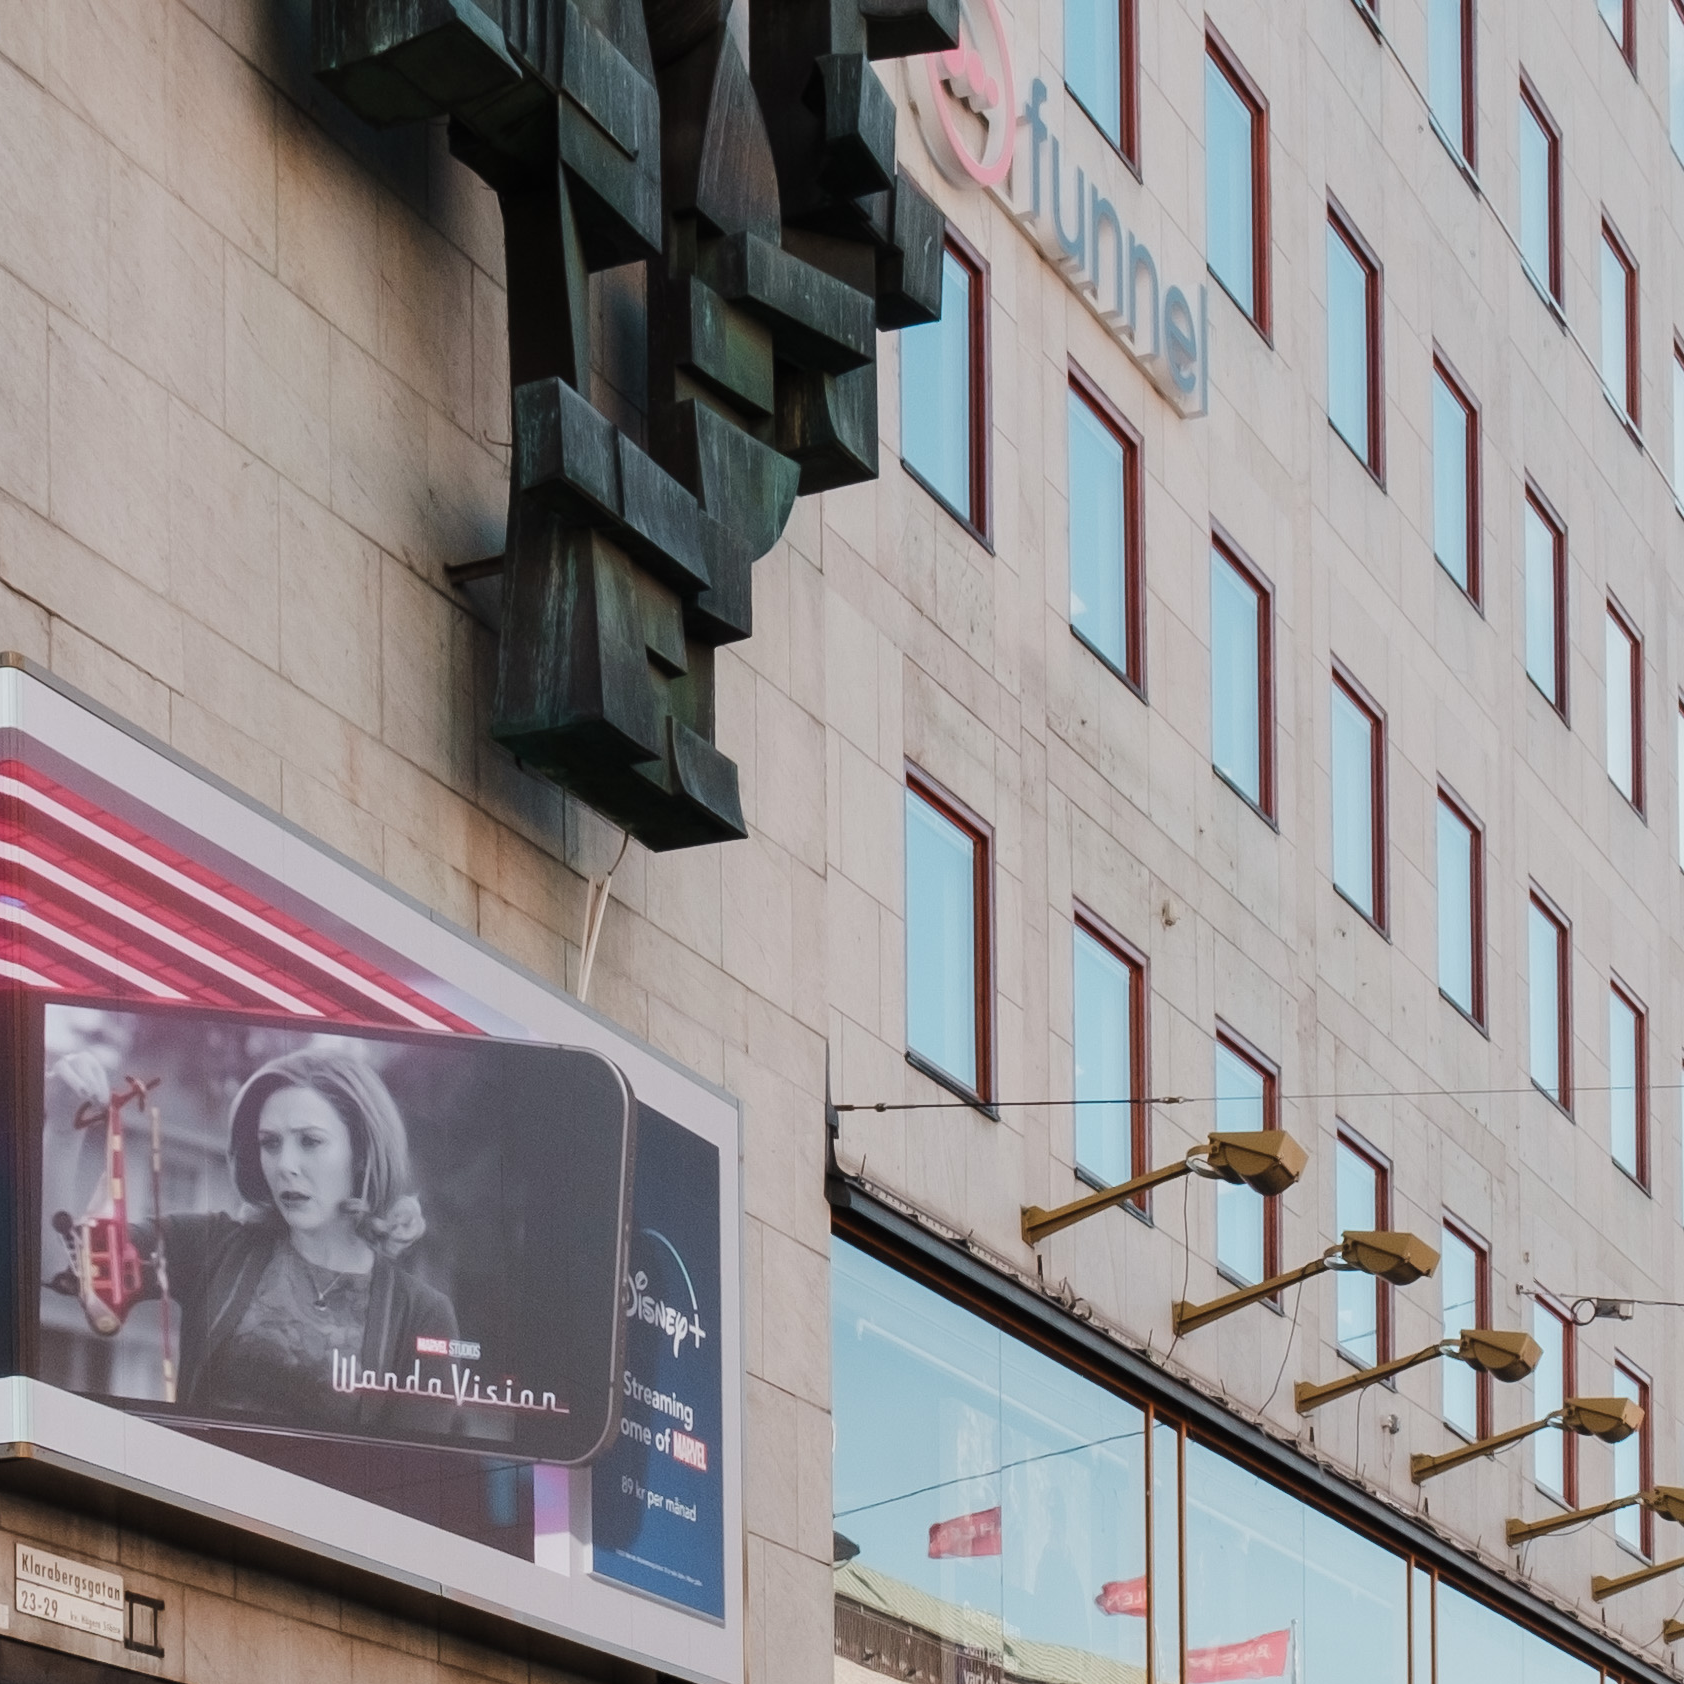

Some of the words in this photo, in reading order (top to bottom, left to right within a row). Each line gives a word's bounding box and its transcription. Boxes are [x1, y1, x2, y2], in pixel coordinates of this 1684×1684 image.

[1025, 77, 1209, 415] funnel
[623, 1370, 694, 1431] Streaming
[620, 1417, 652, 1446] ome
[655, 1428, 671, 1454] of
[672, 1430, 708, 1471] MARVEL
[621, 1475, 633, 1494] 89
[635, 1481, 646, 1500] kr
[647, 1490, 664, 1509] per
[665, 1496, 697, 1523] månad
[20, 1552, 121, 1602] Klarabergsgatan
[20, 1590, 59, 1619] 23-29
